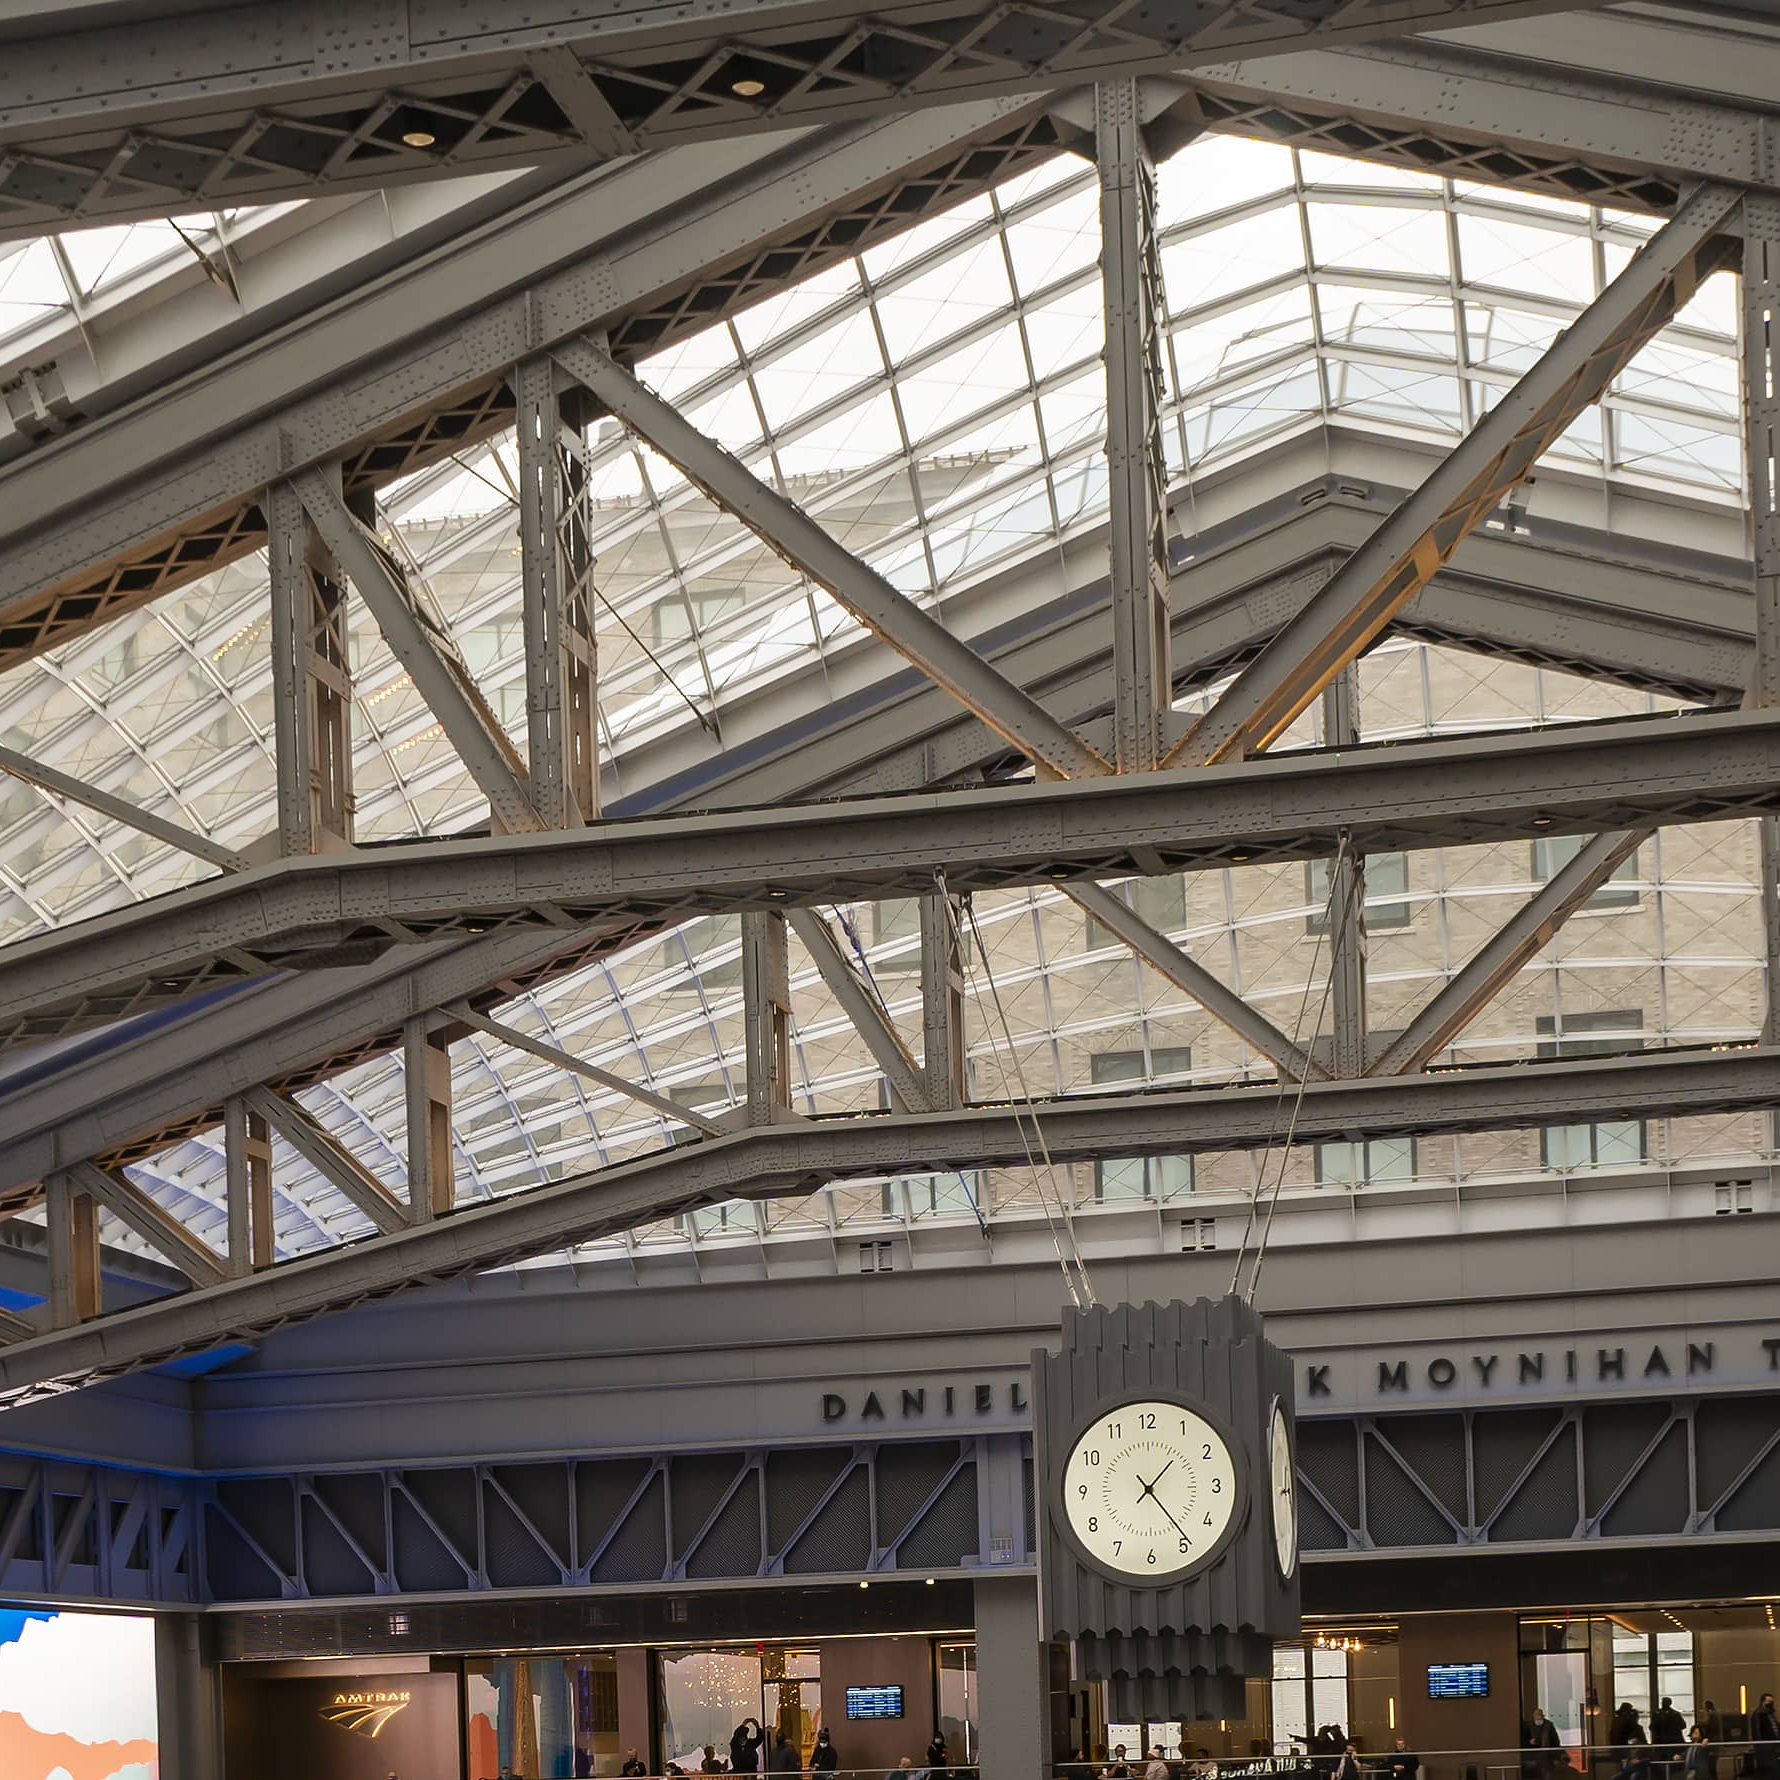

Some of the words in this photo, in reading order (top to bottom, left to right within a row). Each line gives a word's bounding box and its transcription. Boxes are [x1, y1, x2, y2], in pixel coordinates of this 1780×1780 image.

[822, 1382, 1028, 1419] DANIEL
[1377, 1342, 1715, 1393] MOYNIHAN
[1138, 1413, 1156, 1429] 12
[1179, 1420, 1186, 1435] 1
[1108, 1424, 1121, 1439] 11
[1083, 1450, 1100, 1466] 10
[1202, 1444, 1212, 1460] 2
[1078, 1485, 1088, 1500] 9
[1211, 1478, 1221, 1493] 3
[1088, 1516, 1098, 1532] 8
[1202, 1511, 1213, 1527] 4
[1113, 1541, 1122, 1556] 7
[1179, 1538, 1189, 1553] 5
[1147, 1549, 1156, 1564] 6
[334, 1691, 411, 1704] AMTRAK
